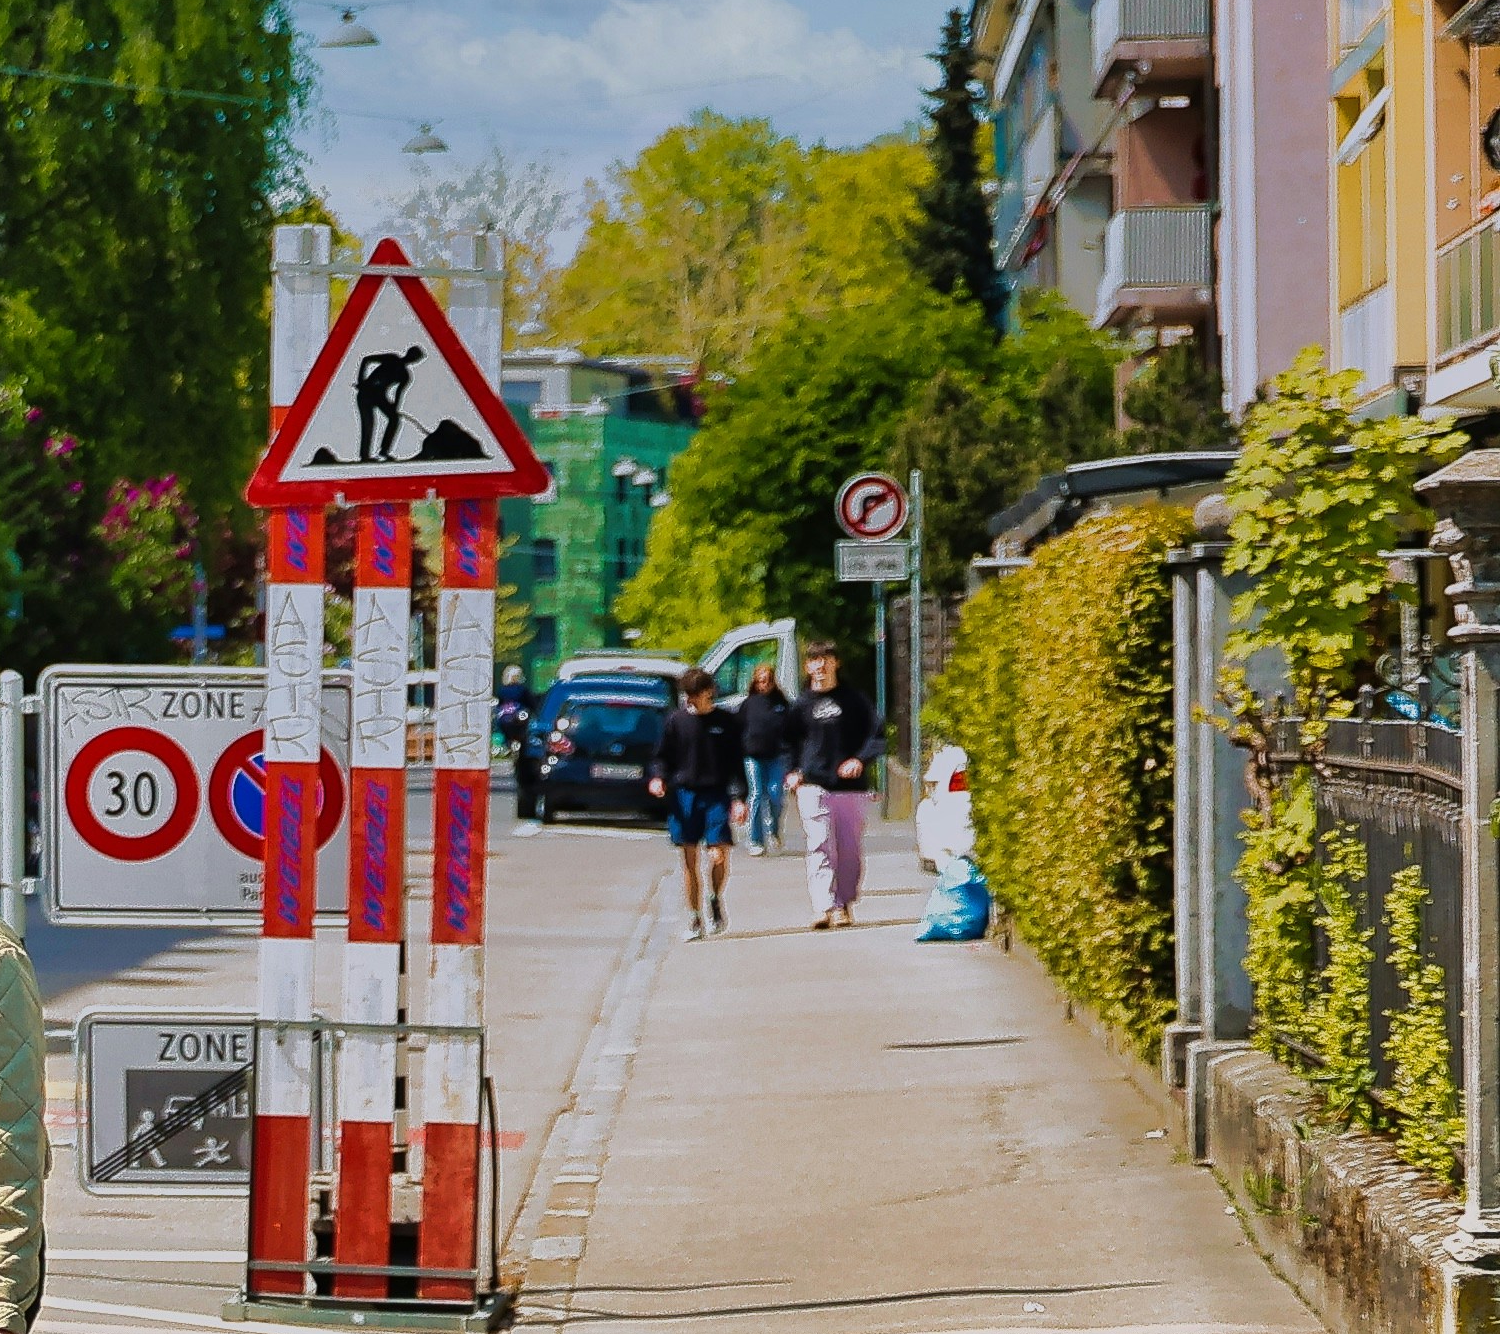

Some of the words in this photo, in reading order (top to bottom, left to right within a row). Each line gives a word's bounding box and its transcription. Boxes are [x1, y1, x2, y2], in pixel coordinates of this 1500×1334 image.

[162, 691, 246, 719] ZONE
[104, 770, 160, 818] 30
[158, 1033, 248, 1063] ZONE
